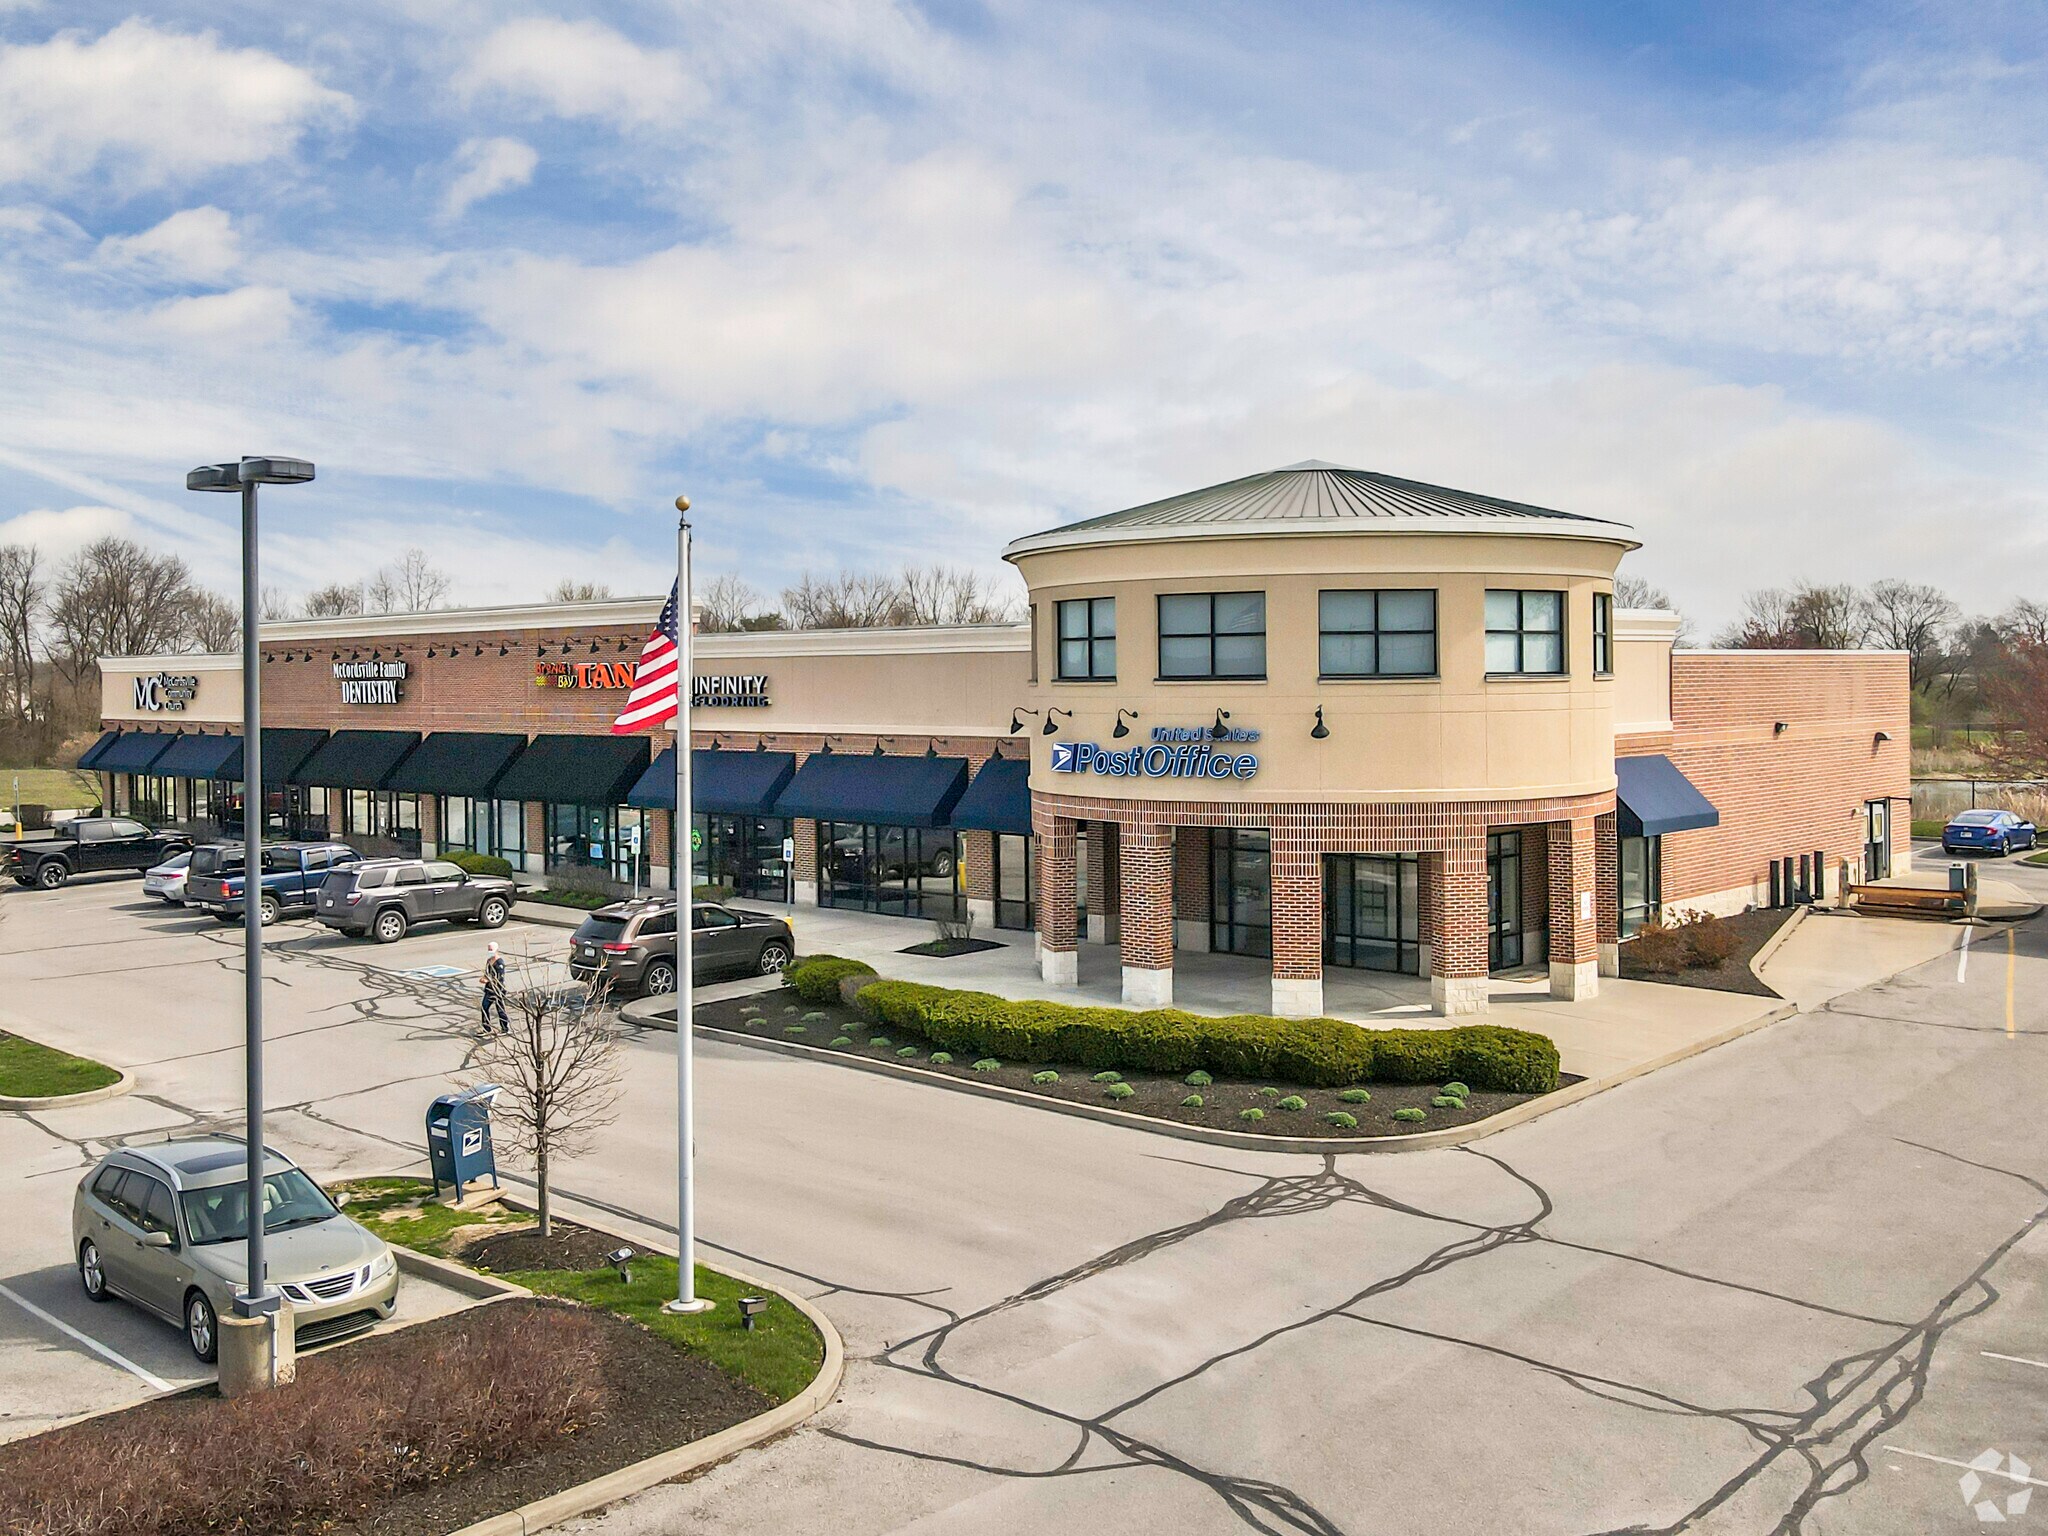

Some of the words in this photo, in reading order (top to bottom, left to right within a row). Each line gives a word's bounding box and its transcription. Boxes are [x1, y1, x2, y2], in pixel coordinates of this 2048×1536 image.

[332, 662, 378, 679] McCordsville
[379, 660, 407, 680] Family
[573, 662, 639, 689] TAN
[341, 680, 398, 704] DENTISTRY
[694, 675, 766, 695] INFINITY
[694, 694, 767, 707] FLOORING
[1151, 727, 1203, 742] United
[1204, 728, 1259, 742] Sates
